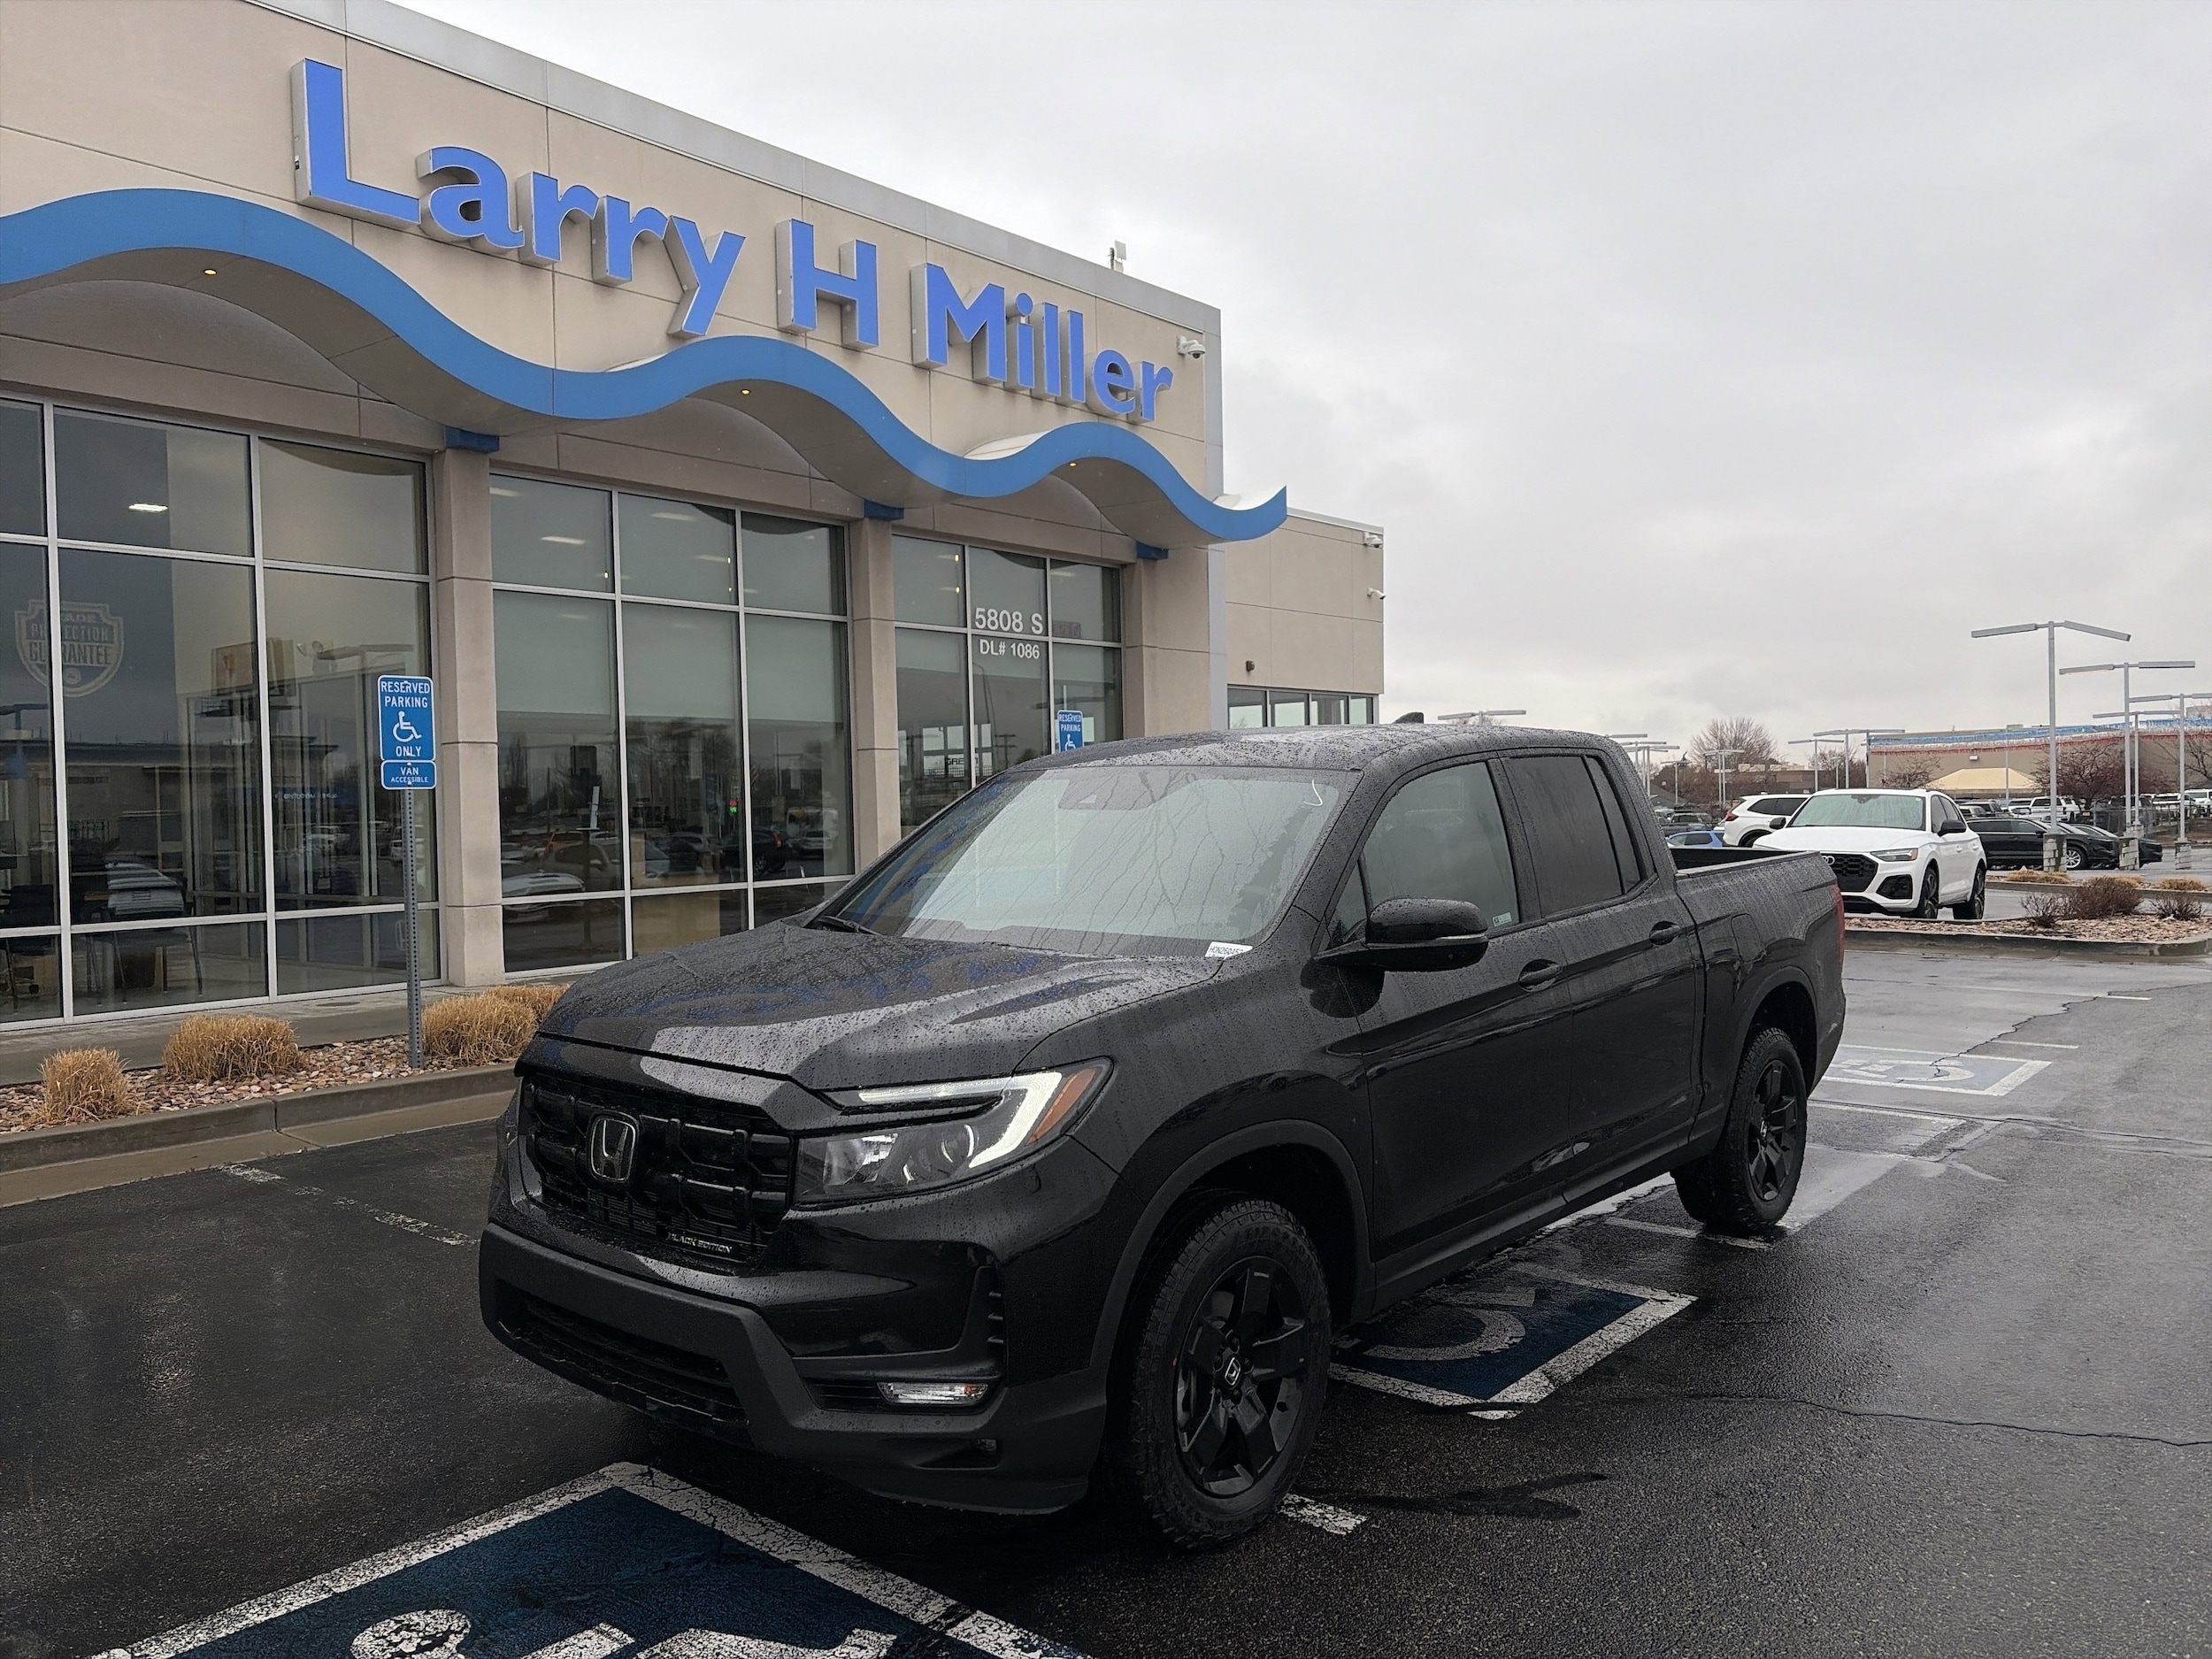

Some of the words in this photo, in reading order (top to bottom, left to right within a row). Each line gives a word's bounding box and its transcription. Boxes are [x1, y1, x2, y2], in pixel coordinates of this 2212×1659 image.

[292, 58, 746, 337] Larry
[776, 219, 879, 350] H
[910, 263, 1173, 423] Miller
[975, 607, 1024, 633] 5808
[1031, 613, 1044, 634] S
[31, 622, 108, 641] PRECTION
[979, 639, 1006, 656] DL#
[1010, 642, 1041, 659] 1086
[380, 681, 430, 694] RESERVED
[384, 696, 428, 708] PARKING
[1059, 713, 1081, 722] RESERVED
[396, 746, 422, 757] ONLY
[400, 766, 419, 775] VAN
[666, 1233, 696, 1246] BLACK
